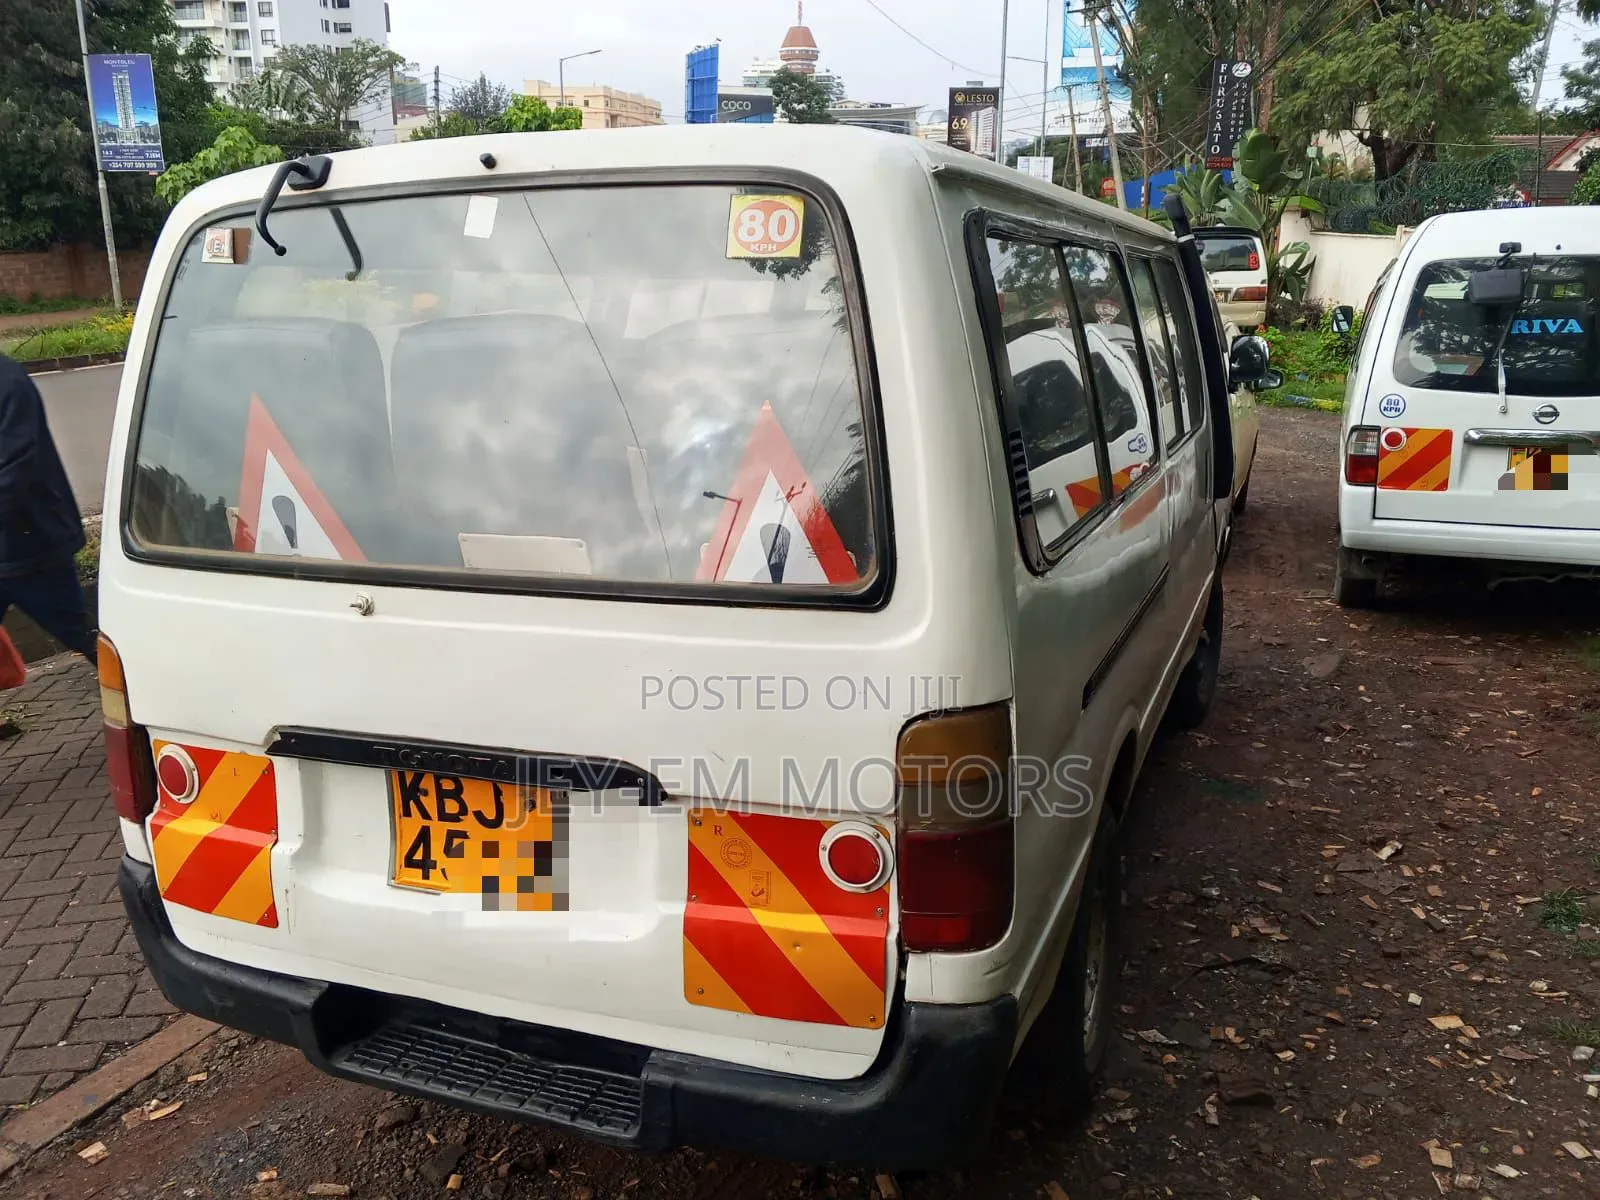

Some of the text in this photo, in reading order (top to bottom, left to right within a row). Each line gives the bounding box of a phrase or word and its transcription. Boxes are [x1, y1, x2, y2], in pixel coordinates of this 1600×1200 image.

[721, 100, 752, 110] COCO
[1211, 63, 1228, 154] FURUSATO
[738, 207, 796, 243] 80
[750, 243, 777, 252] KPH
[1250, 255, 1258, 266] 3
[1386, 398, 1400, 406] 80
[398, 770, 505, 829] KBJ
[713, 824, 724, 836] R
